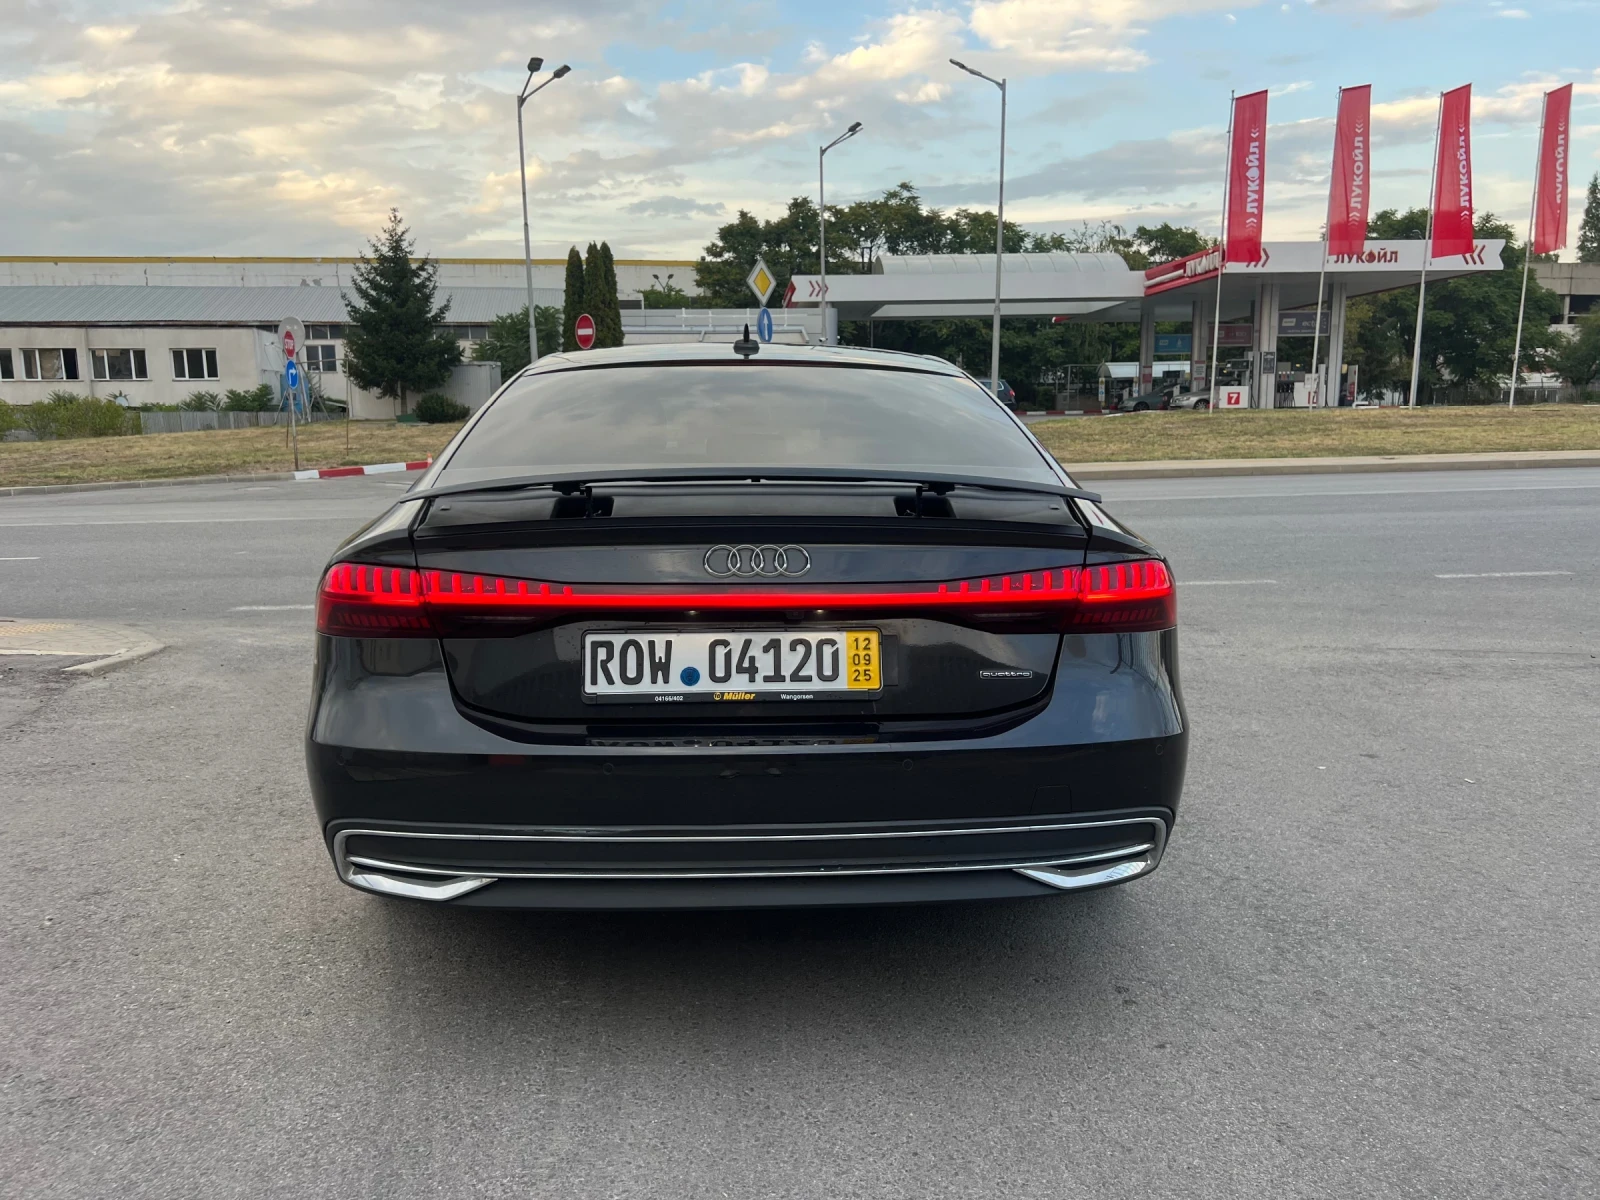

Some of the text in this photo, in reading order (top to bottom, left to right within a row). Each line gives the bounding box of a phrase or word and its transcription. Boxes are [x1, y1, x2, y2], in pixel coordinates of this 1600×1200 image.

[1246, 141, 1260, 214] ЛУКОЙЛ
[1350, 136, 1364, 209] ЛУКОЙЛ
[1457, 135, 1470, 208] ЛУКОЙЛ
[1334, 247, 1399, 264] ЛУКОЙЛ
[1230, 393, 1238, 403] 7
[854, 637, 871, 650] 12
[590, 638, 840, 686] ROW 04120
[852, 653, 871, 666] 09
[853, 669, 872, 682] 25
[723, 691, 756, 700] Müller
